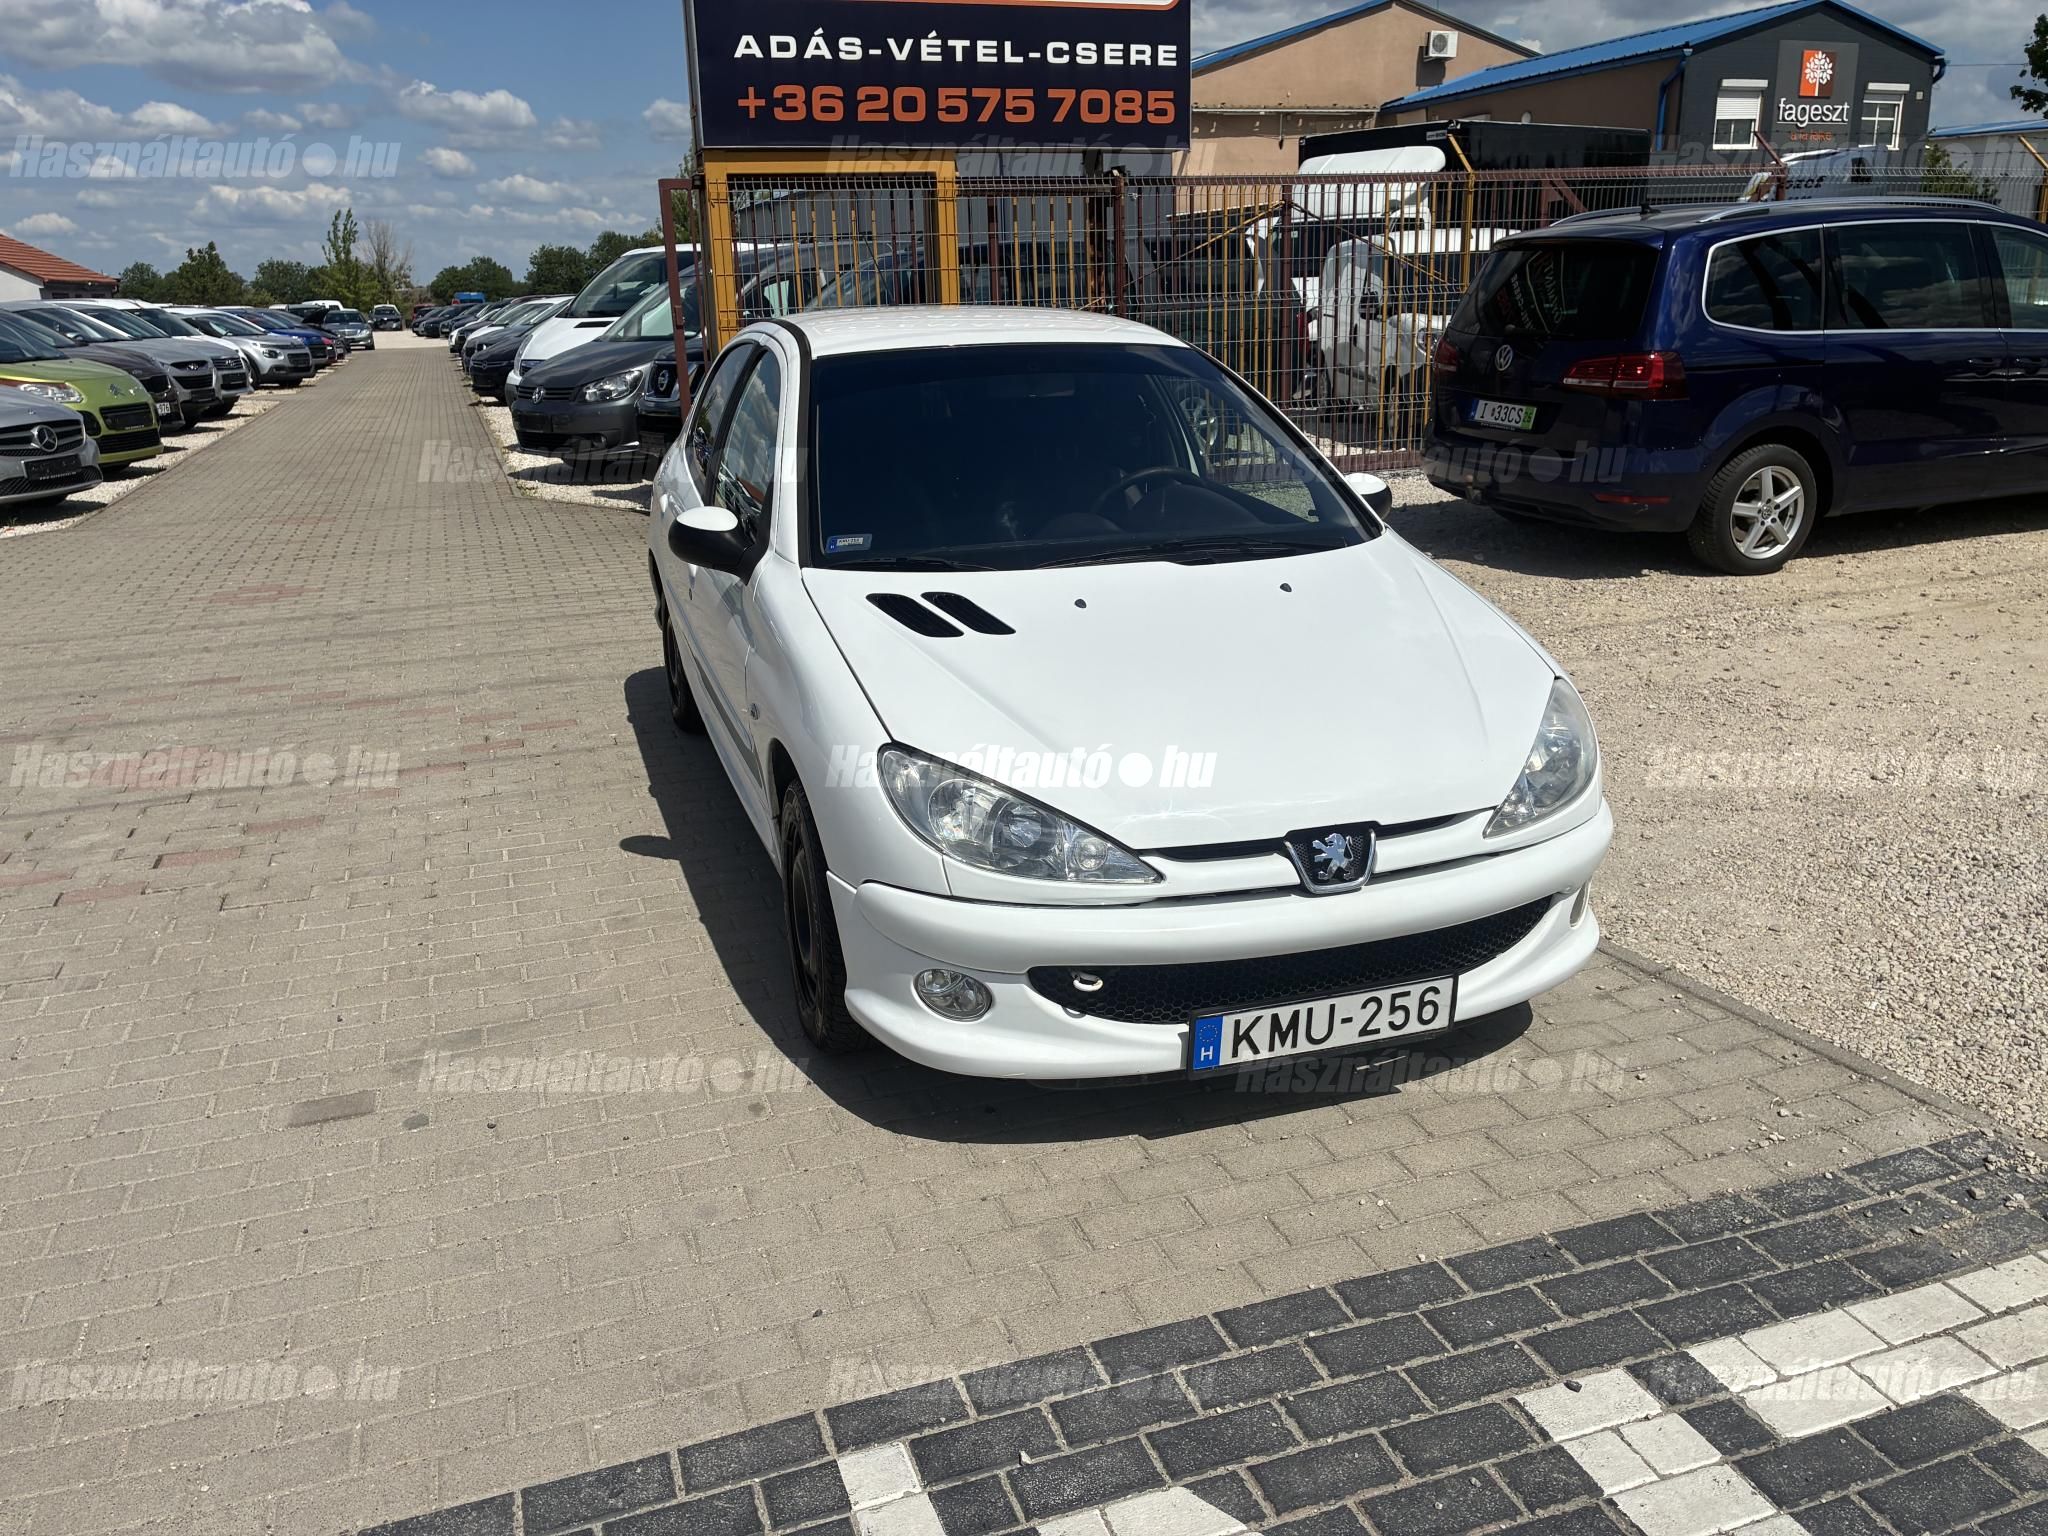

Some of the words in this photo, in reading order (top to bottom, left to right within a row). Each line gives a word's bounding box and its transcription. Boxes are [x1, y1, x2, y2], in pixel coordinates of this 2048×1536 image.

[734, 27, 1177, 66] ADÁS-VÉTEL-CSERE
[738, 85, 844, 122] +36
[857, 86, 926, 122] 20
[937, 87, 1035, 123] 575
[1048, 88, 1175, 124] 7085
[1778, 97, 1850, 128] fageszt
[1231, 985, 1441, 1059] KMU-256
[1200, 1046, 1213, 1061] H
